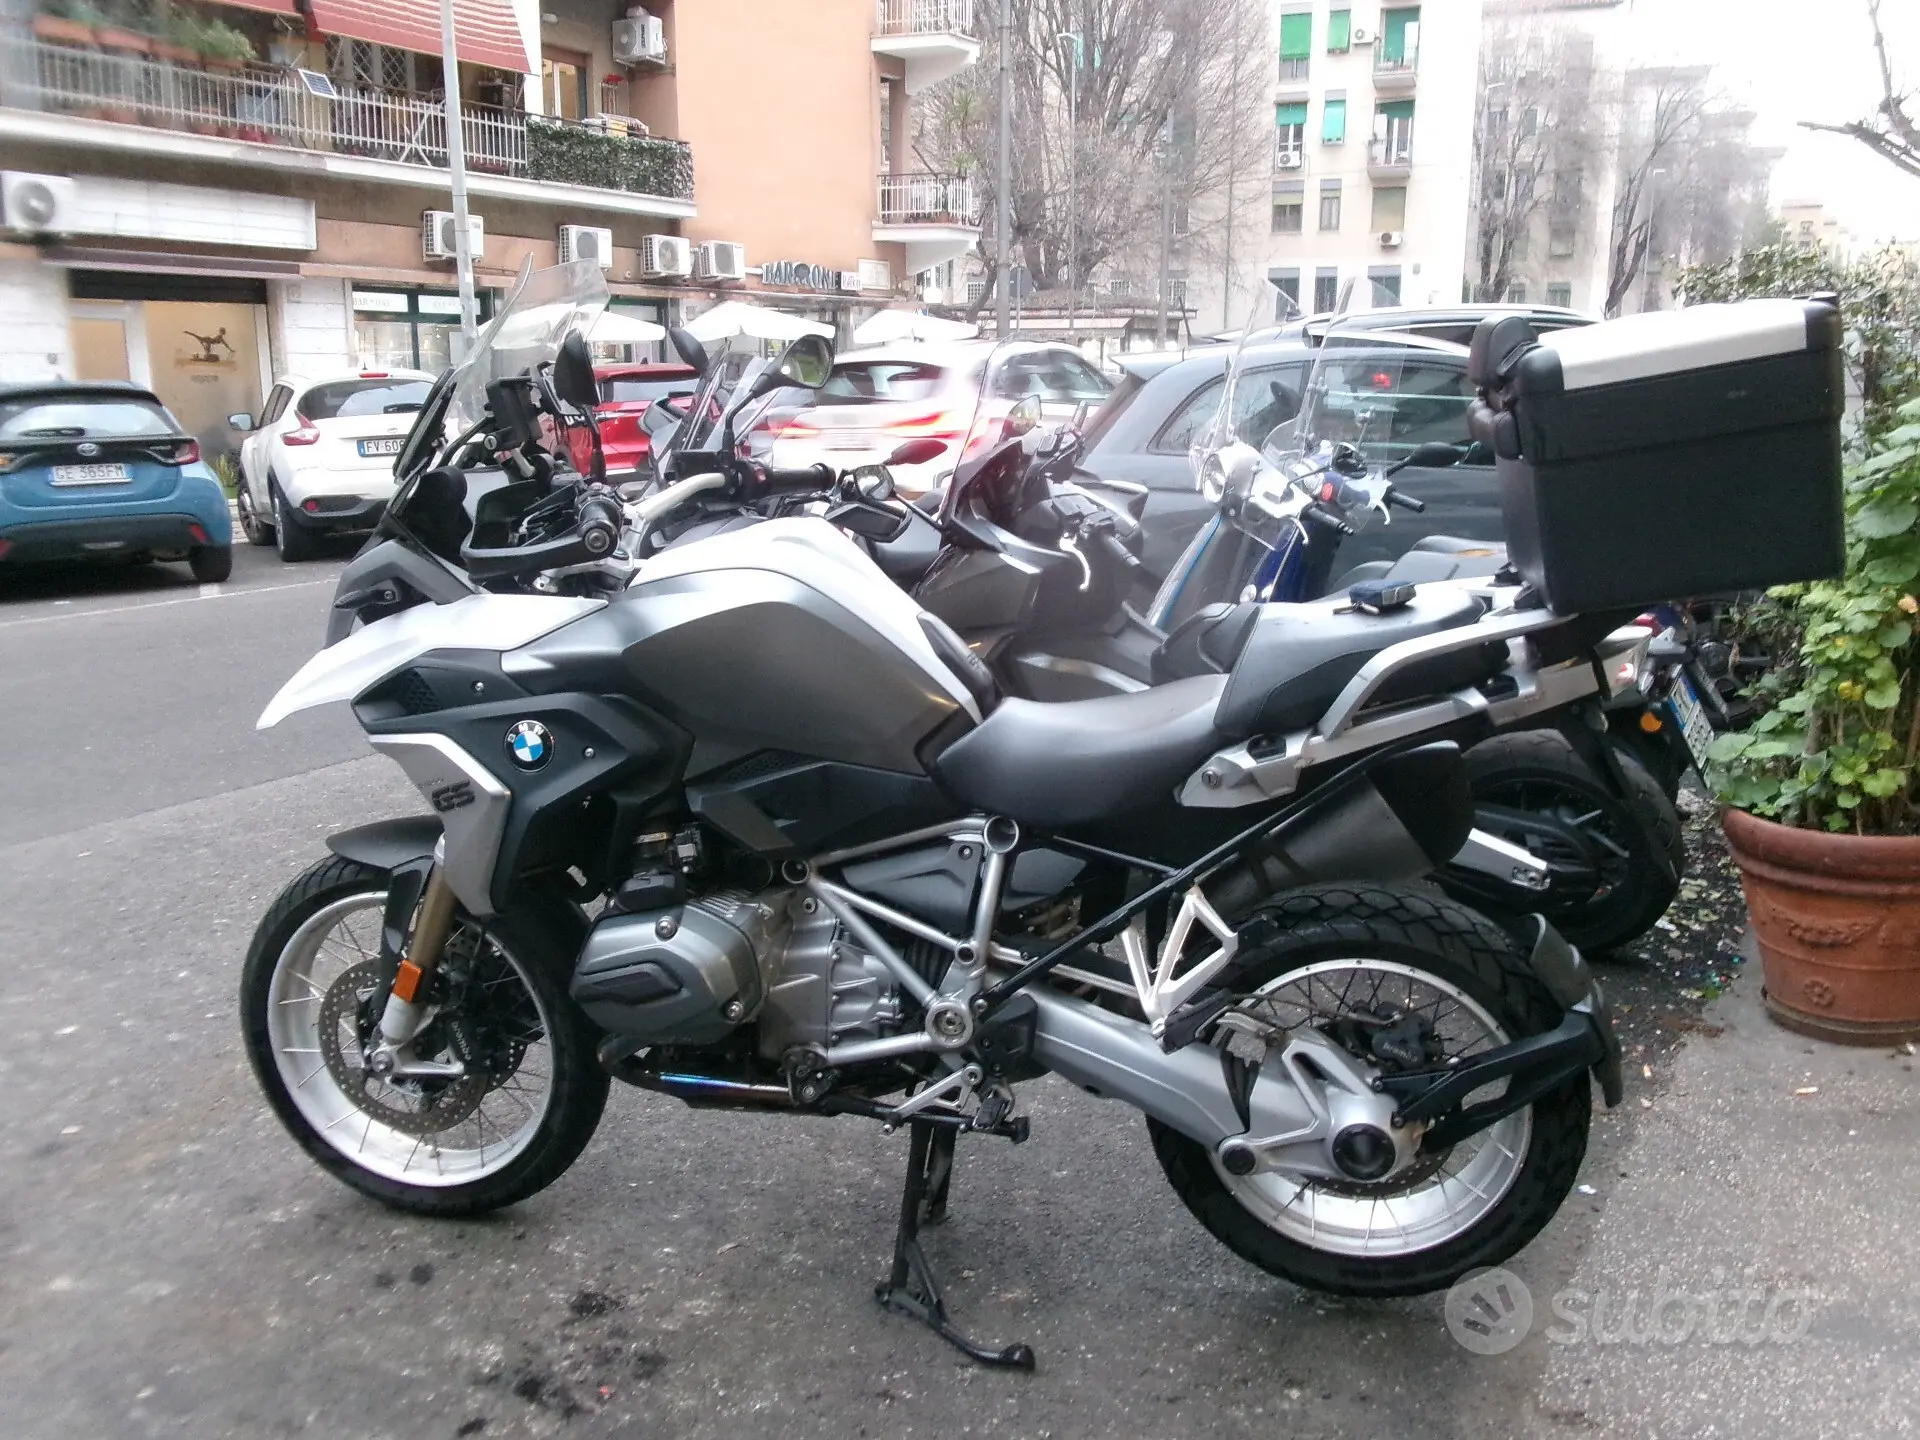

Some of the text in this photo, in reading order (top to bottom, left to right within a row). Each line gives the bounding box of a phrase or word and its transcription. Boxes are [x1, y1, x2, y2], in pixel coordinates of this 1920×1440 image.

[366, 441, 380, 452] FV
[507, 722, 545, 743] BMW
[432, 779, 476, 812] GS
